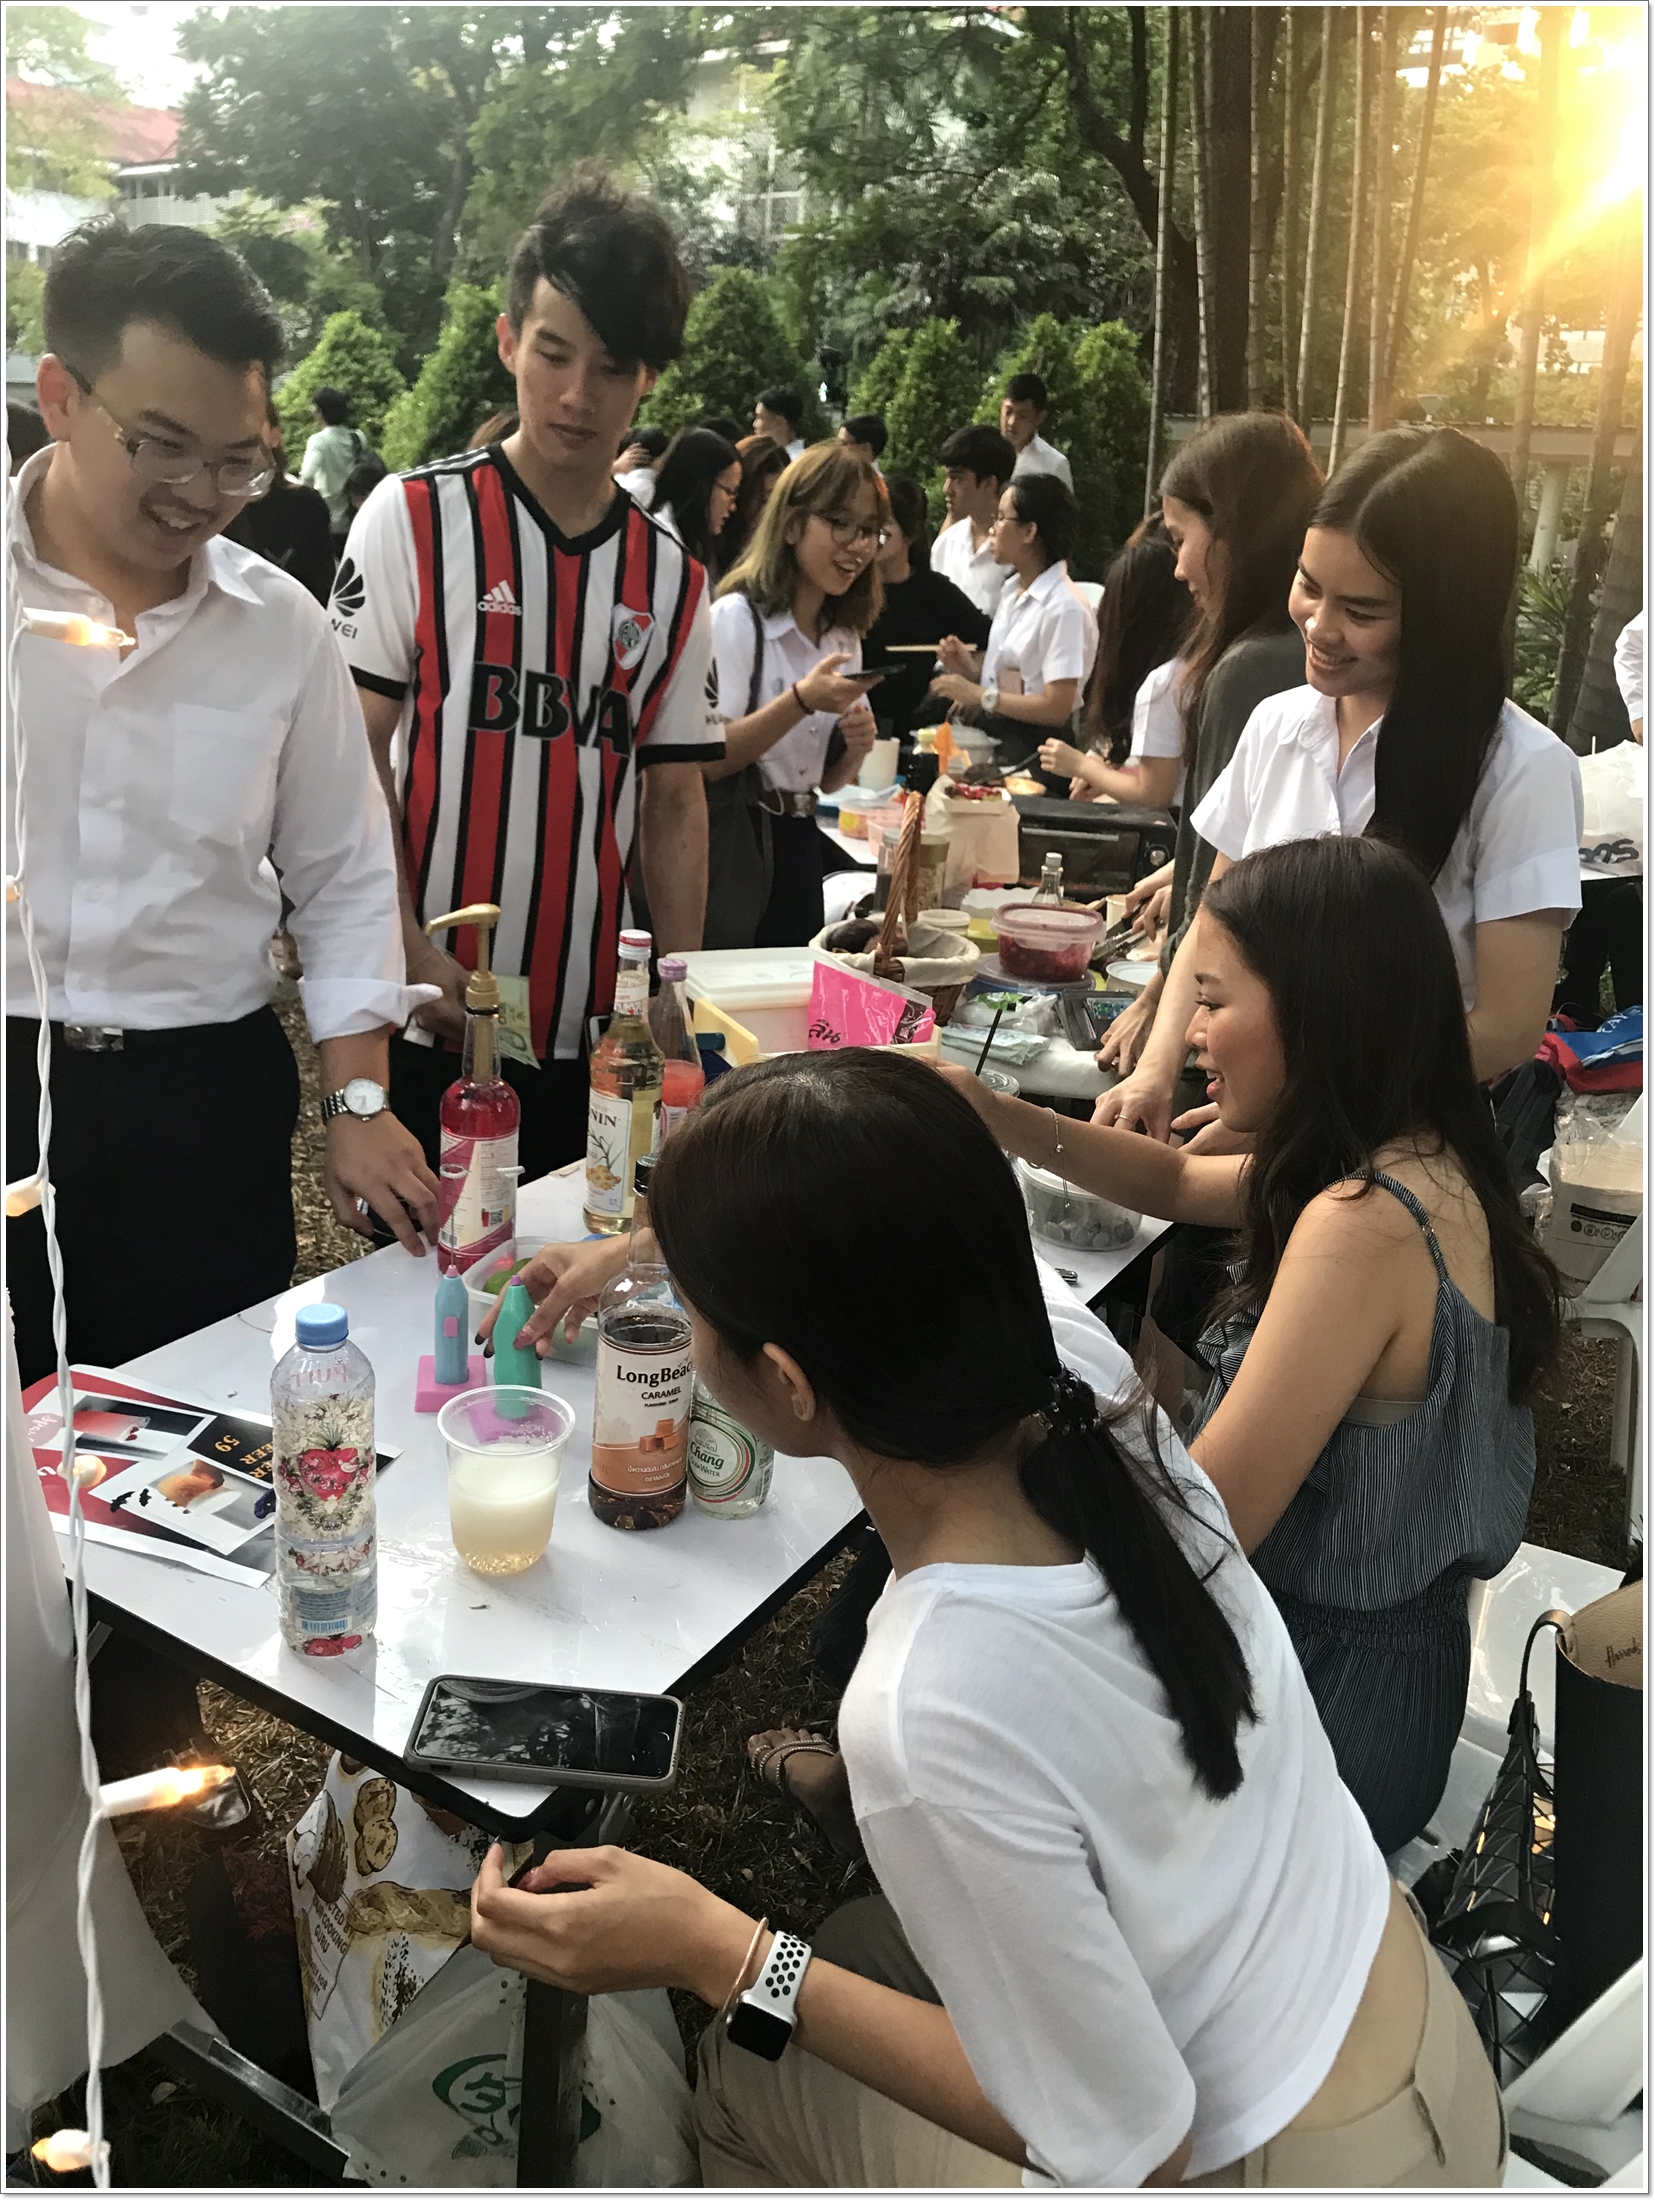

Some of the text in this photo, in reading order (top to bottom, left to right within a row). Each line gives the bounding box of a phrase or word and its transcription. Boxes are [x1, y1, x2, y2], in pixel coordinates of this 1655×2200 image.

[477, 601, 522, 616] adidas
[468, 661, 637, 758] BBVA
[616, 1361, 693, 1388] LongBeac
[641, 1386, 681, 1400] CARAMEL
[215, 1434, 240, 1452] 59
[690, 1441, 725, 1470] Chang
[314, 1924, 331, 1953] GURU
[321, 1913, 349, 1955] COOKING
